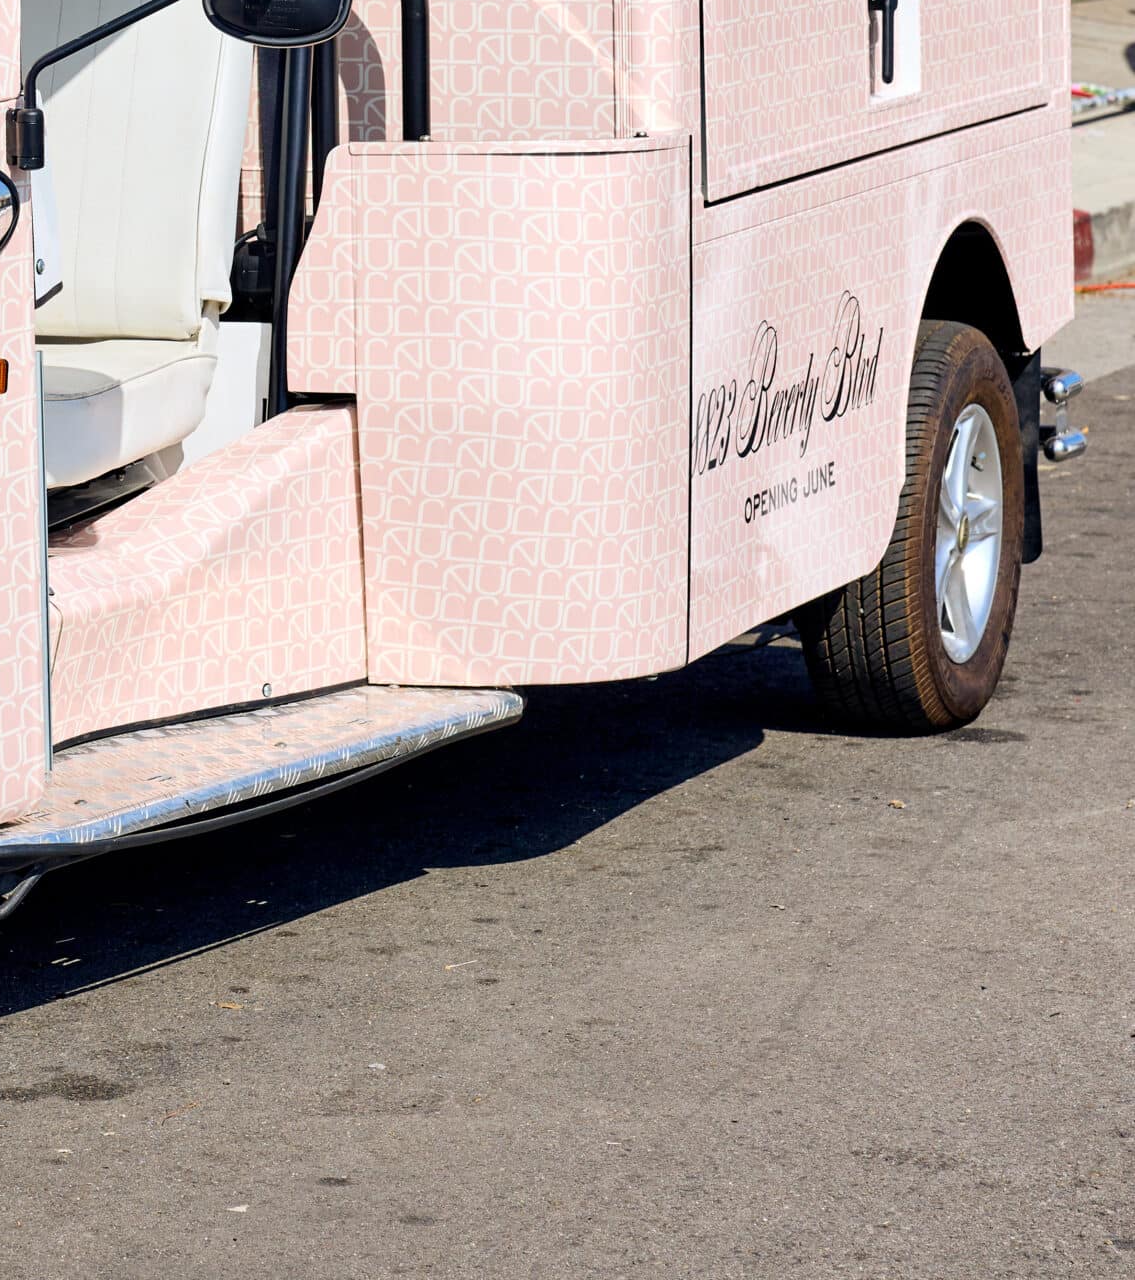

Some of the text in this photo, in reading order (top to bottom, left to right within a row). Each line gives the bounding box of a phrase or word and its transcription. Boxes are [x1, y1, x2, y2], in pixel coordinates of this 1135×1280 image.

[735, 319, 820, 458] Beverly
[821, 289, 884, 421] Blvd
[744, 461, 836, 524] OPENING JUNE
